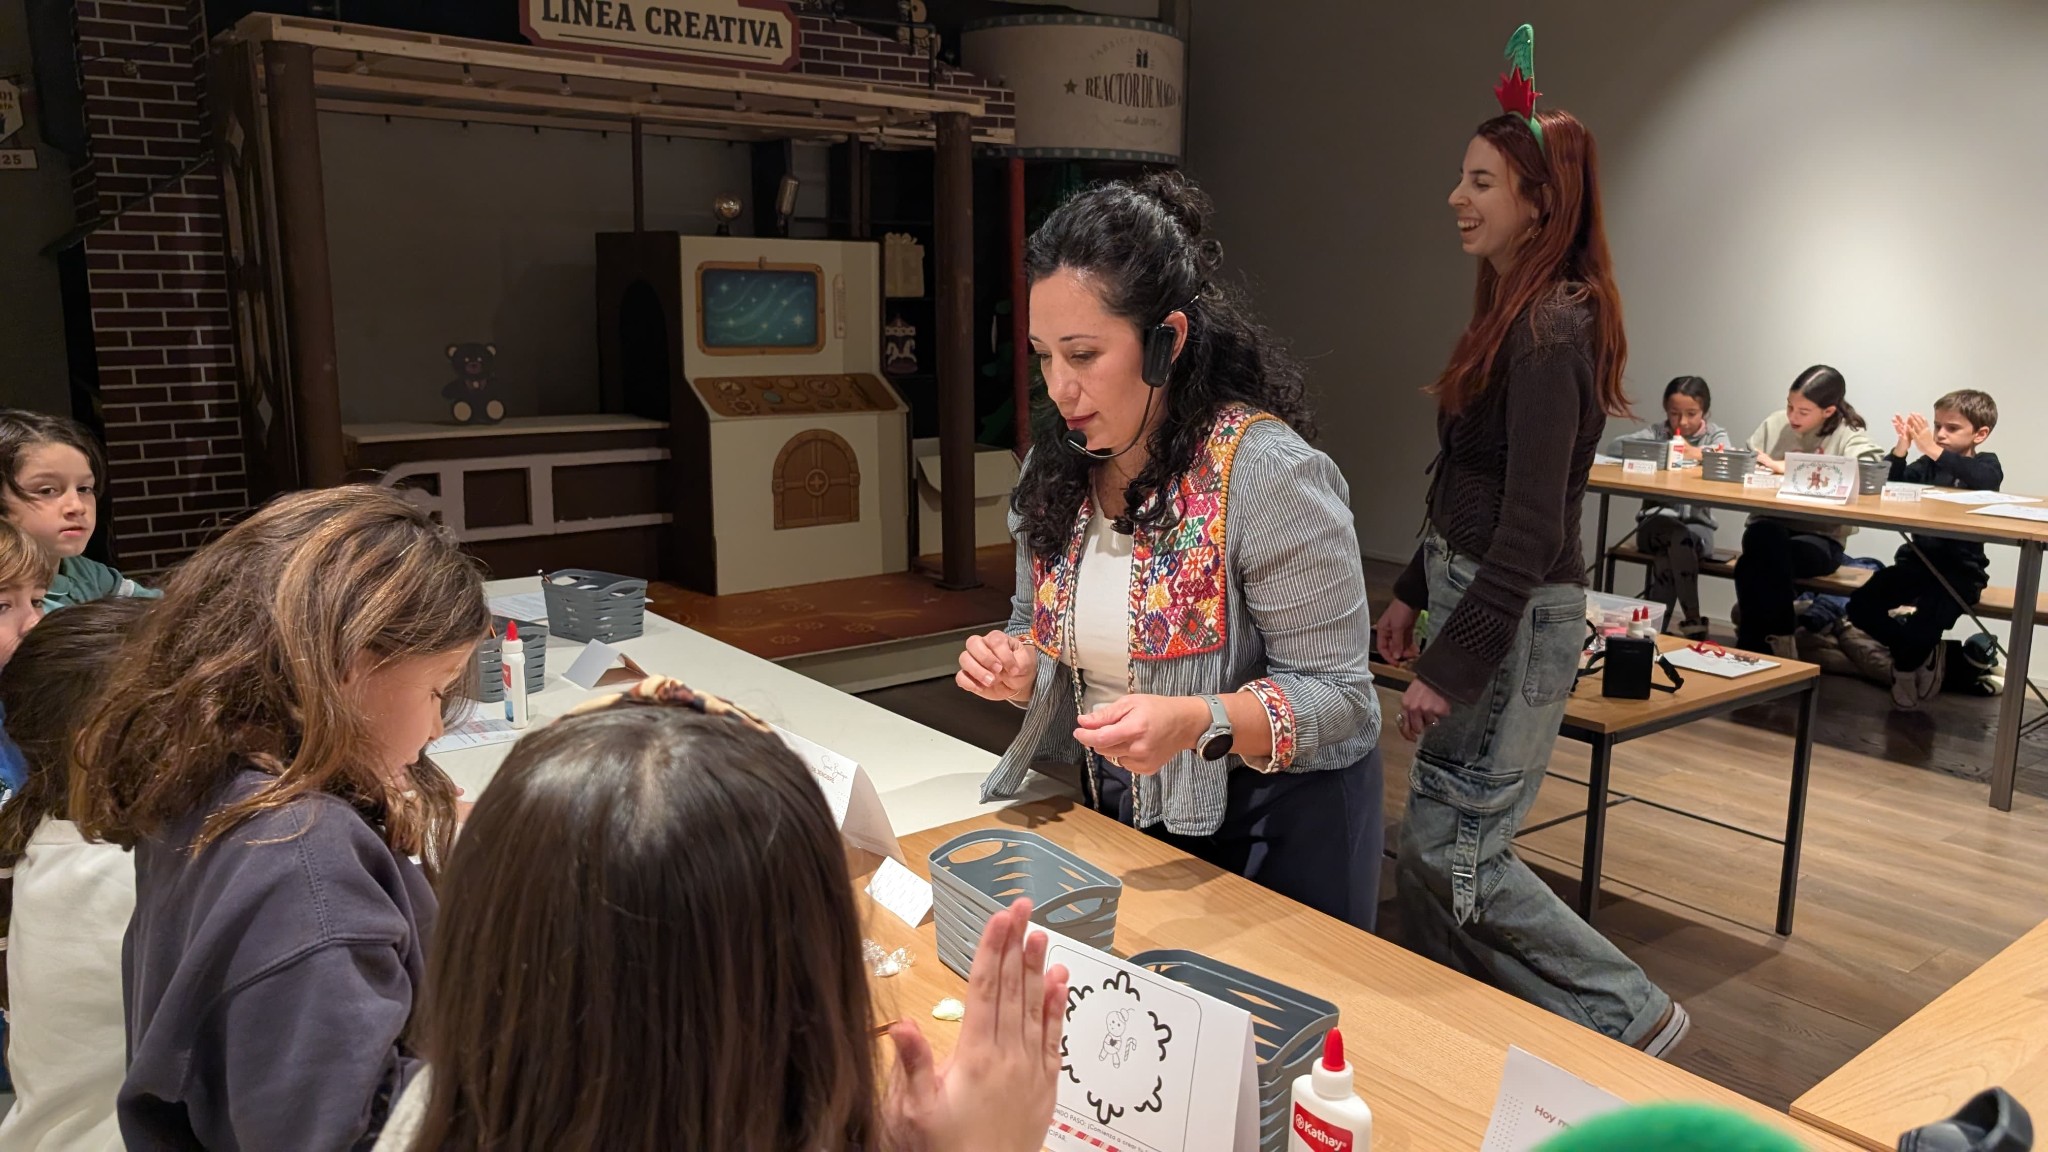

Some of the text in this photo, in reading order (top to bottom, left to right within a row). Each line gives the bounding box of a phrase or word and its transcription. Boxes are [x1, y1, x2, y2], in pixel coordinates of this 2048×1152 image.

[645, 7, 783, 49] CREATIVA
[1085, 72, 1140, 108] REACTOR
[1141, 74, 1155, 108] DE
[1534, 1104, 1557, 1123] Hoy
[1048, 1129, 1066, 1141] CIPAR.
[1304, 1121, 1343, 1151] Kathay
